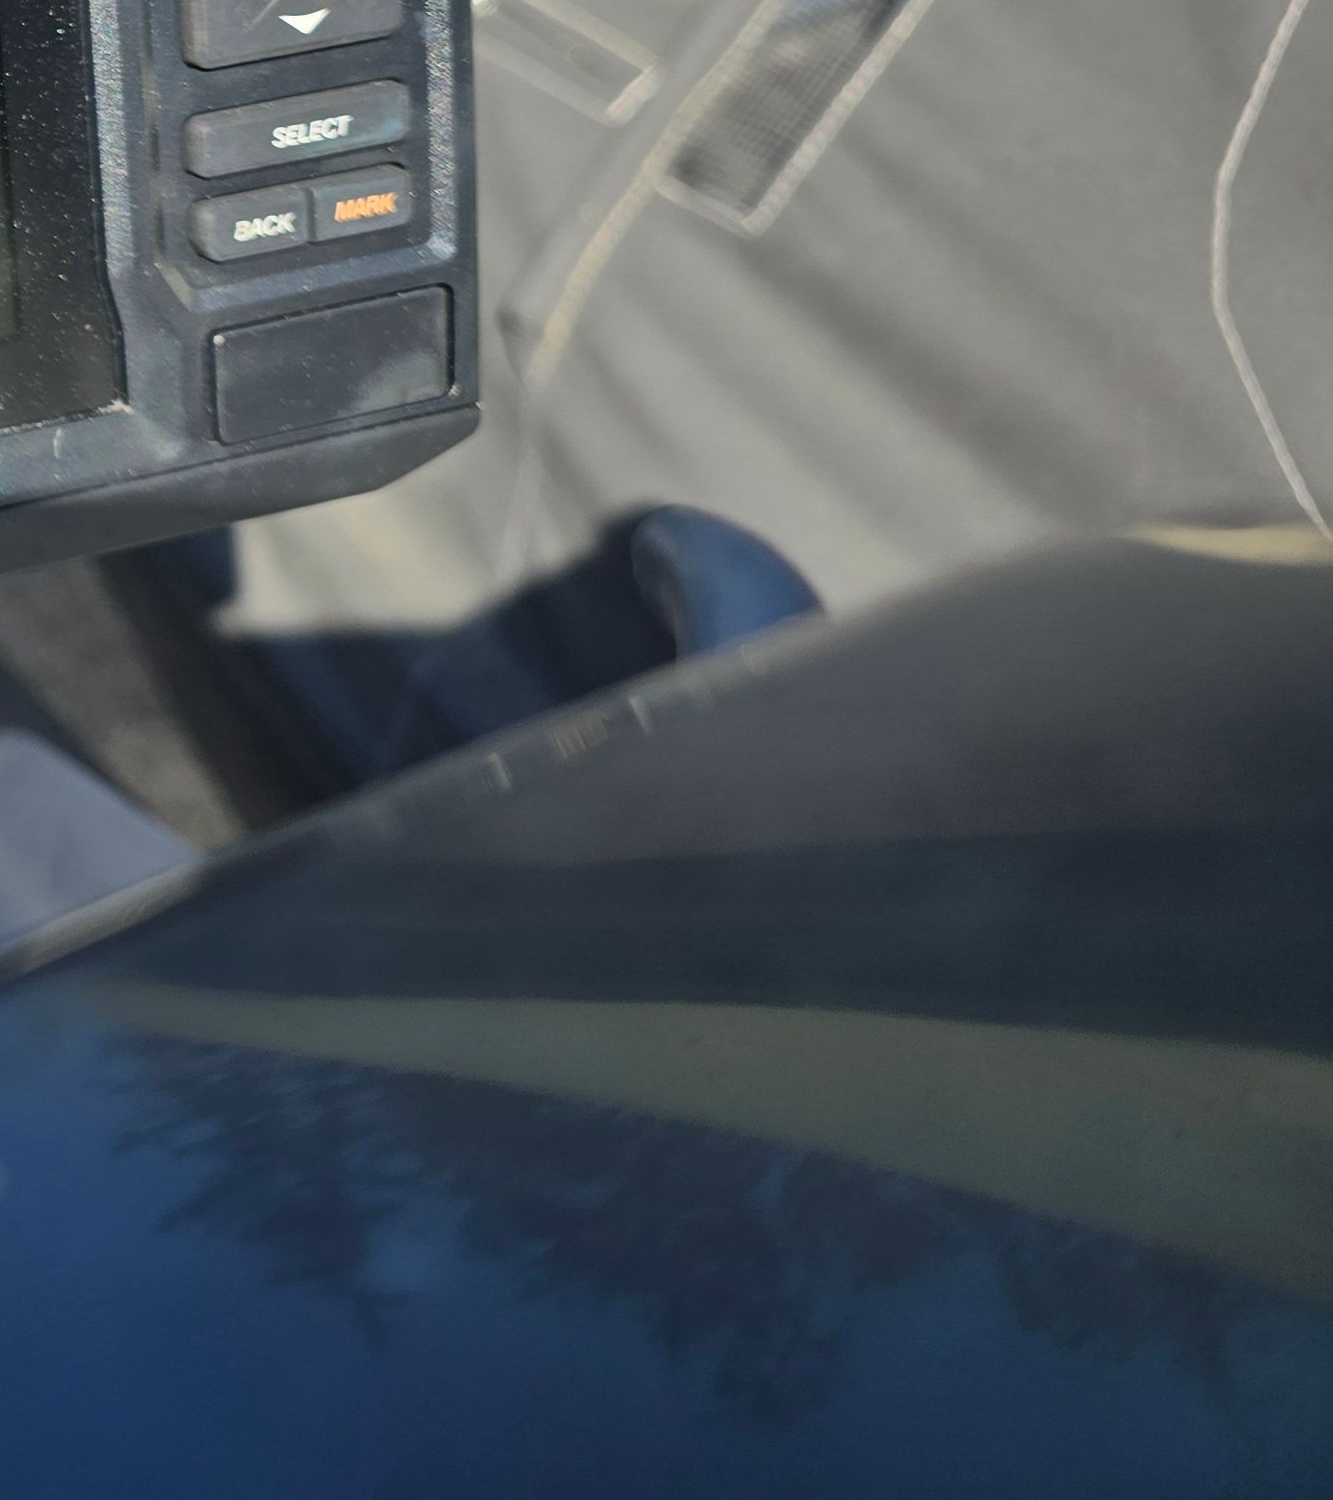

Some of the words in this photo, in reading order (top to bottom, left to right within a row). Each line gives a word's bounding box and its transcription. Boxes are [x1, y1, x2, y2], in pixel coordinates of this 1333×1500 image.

[271, 114, 354, 148] SELECT
[334, 191, 398, 223] MARK
[234, 211, 297, 242] BACK
